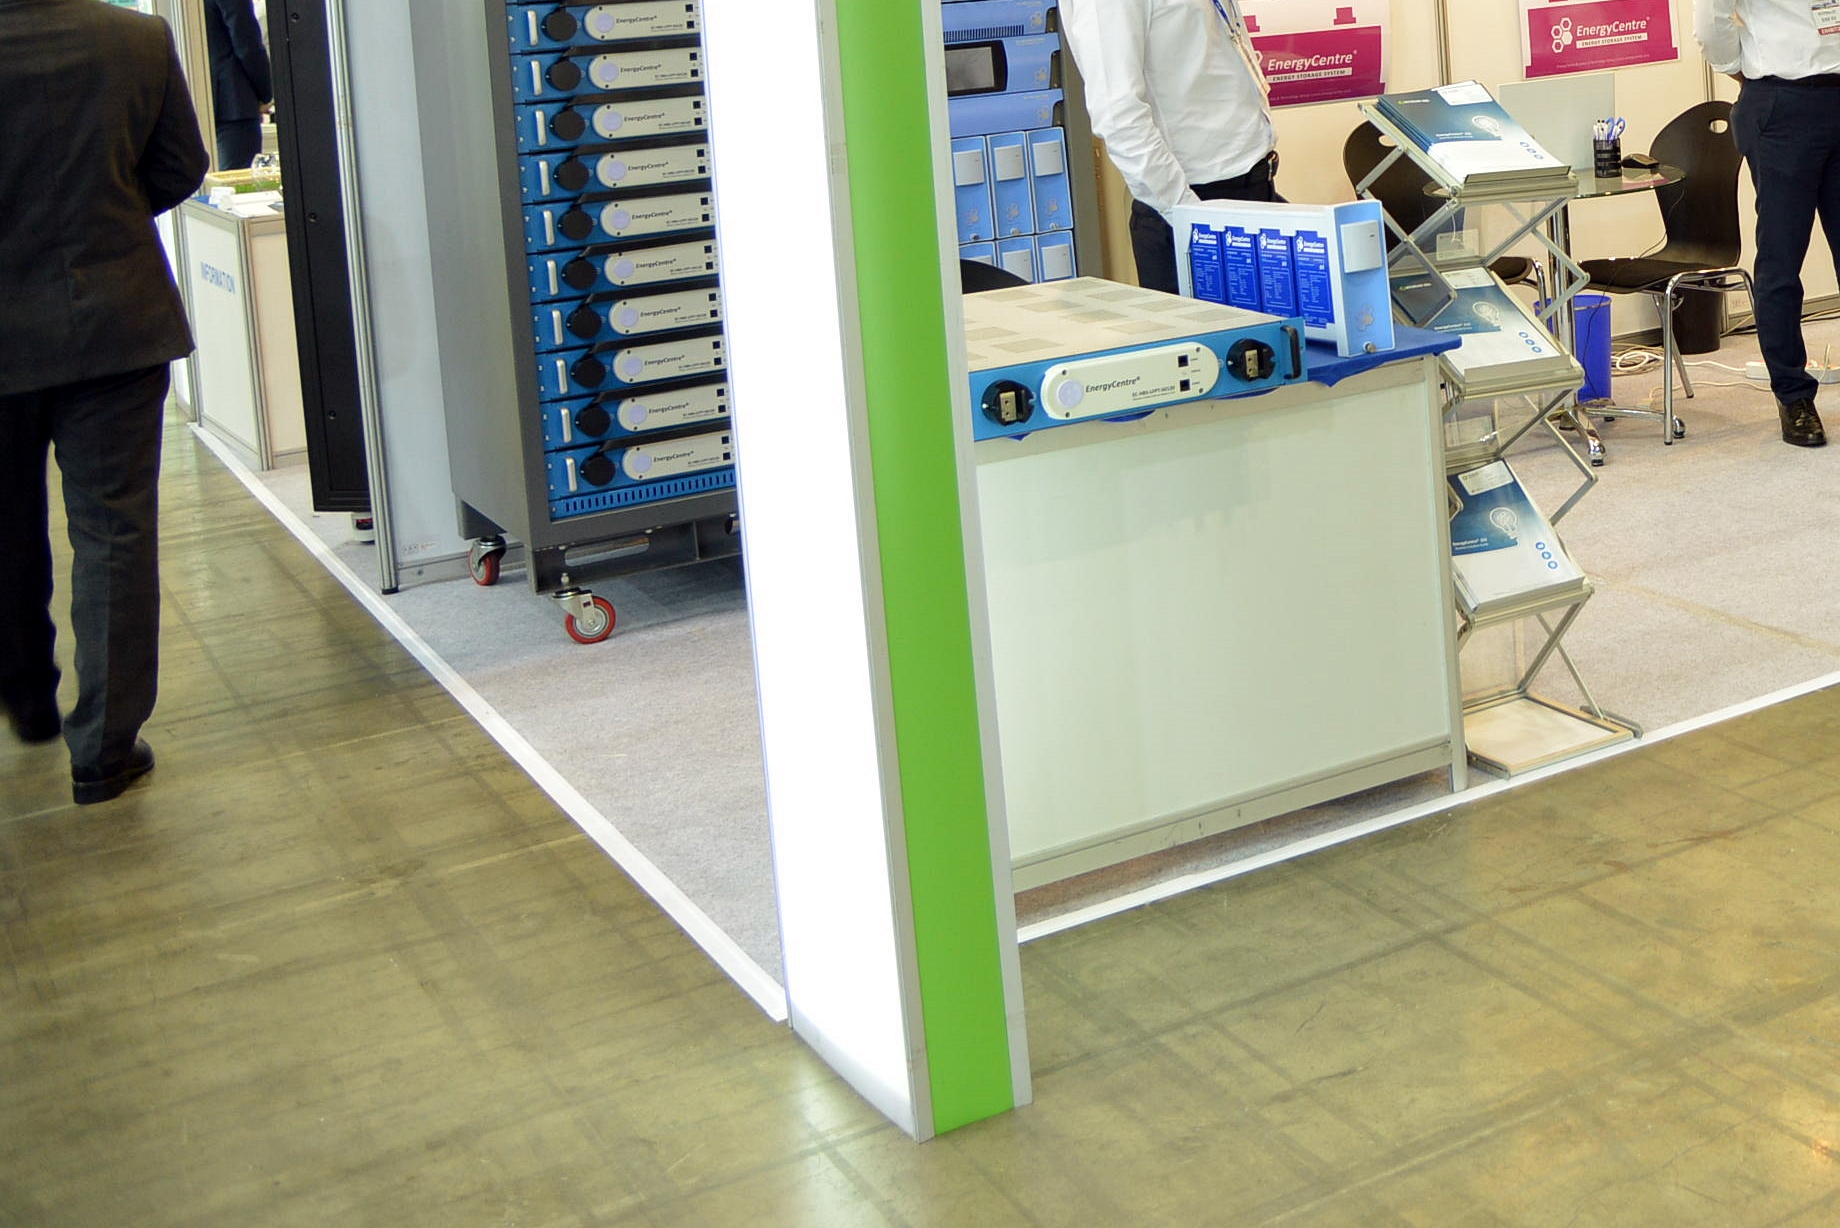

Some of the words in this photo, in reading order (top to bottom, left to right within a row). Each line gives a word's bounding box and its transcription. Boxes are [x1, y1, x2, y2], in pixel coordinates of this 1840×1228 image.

[1576, 19, 1647, 36] EnergyCentre
[1267, 53, 1353, 72] EnergyCentre
[1272, 74, 1295, 82] ENERGY
[1297, 72, 1322, 80] STORAGE
[1085, 377, 1137, 393] EnergyCentre
